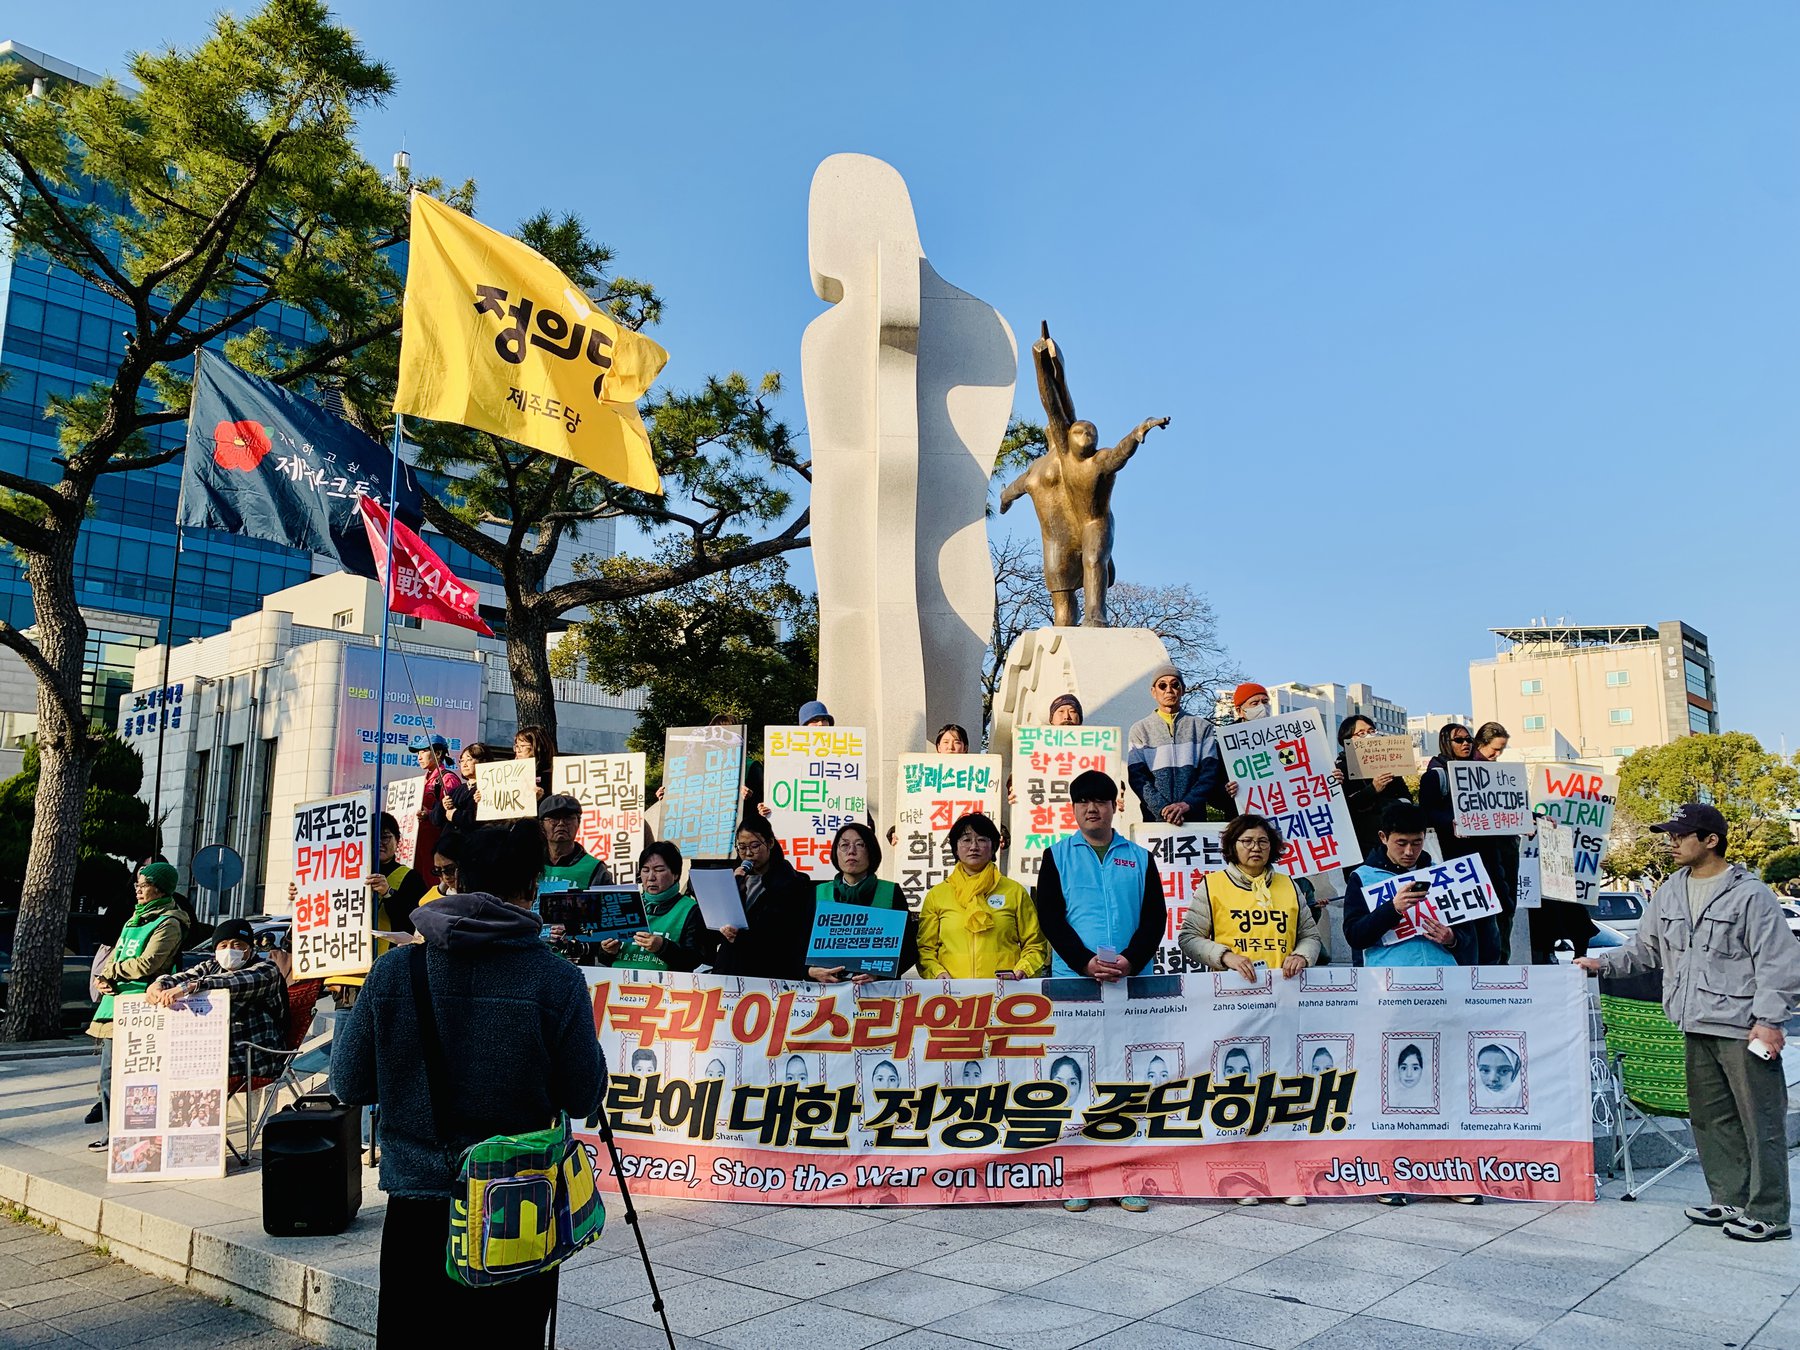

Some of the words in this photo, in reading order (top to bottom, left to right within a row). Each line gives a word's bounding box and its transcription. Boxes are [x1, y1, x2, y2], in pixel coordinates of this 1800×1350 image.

[507, 387, 581, 433] 제주도당
[445, 699, 474, 711] 삽니다.
[393, 713, 436, 729] 2026년,
[769, 731, 863, 757] 한국정부는
[1017, 727, 1118, 755] 팔레스타인
[705, 746, 741, 772] 다시
[809, 760, 859, 781] 미국의
[1029, 751, 1106, 775] 학살에
[1233, 751, 1274, 780] 이란
[1274, 737, 1313, 776] 핵
[565, 759, 633, 785] 미국과
[667, 767, 740, 798] 석유전쟁
[903, 763, 1000, 794] 팔레스타인에
[1454, 766, 1490, 791] END
[1496, 769, 1516, 787] the
[772, 778, 841, 812] 이란에
[845, 796, 865, 813] 대한
[1245, 781, 1288, 816] 시설
[1289, 774, 1340, 808] 공격은
[1545, 768, 1603, 802] WAR
[1601, 795, 1617, 806] on
[494, 789, 525, 812] WAR
[1457, 790, 1529, 813] GENOCIDE!
[295, 800, 368, 842] 제주도정은
[577, 810, 614, 836] 란에
[617, 811, 643, 834] 대한
[899, 808, 923, 824] 대한
[1460, 812, 1491, 831] 학살을
[1148, 835, 1223, 865] 제주는
[1276, 834, 1341, 876] 위반
[296, 841, 363, 885] 무기기업
[295, 889, 330, 932] 한화
[332, 886, 365, 928] 협력
[817, 913, 868, 927] 어린이와
[1230, 909, 1288, 933] 정의당
[814, 937, 871, 949] 미사일전쟁
[829, 927, 852, 936] 민간인
[853, 927, 884, 936] 대량살상
[298, 930, 367, 972] 중단하라
[1233, 938, 1288, 953] 제주도당
[860, 959, 894, 972] 녹색당
[1050, 1009, 1073, 1018] mira
[1075, 1009, 1105, 1017] Malahi
[1212, 1003, 1236, 1011] Zahra
[1237, 1001, 1277, 1011] Soleimani
[118, 1017, 127, 1028] 이
[131, 1014, 165, 1030] 아이들
[593, 981, 727, 1053] 국과
[731, 990, 1056, 1061] 이스라엘은
[127, 1031, 157, 1056] 눈을
[123, 1055, 162, 1075] 보라!
[605, 1072, 724, 1142] 란에
[727, 1080, 864, 1149] 대한
[863, 1080, 1074, 1149] 전쟁을
[1081, 1068, 1358, 1140] 중단하라!
[1371, 1122, 1396, 1130] Liana
[1397, 1121, 1450, 1131] Mohammadi
[1460, 1121, 1512, 1131] fatemezahra
[1513, 1122, 1542, 1131] Karimi
[609, 1147, 702, 1188] Israel,
[711, 1157, 786, 1193] Stop
[792, 1164, 848, 1191] the
[856, 1165, 927, 1188] War
[931, 1165, 977, 1188] on
[985, 1156, 1064, 1189] Iran!
[1324, 1156, 1389, 1186] Jeju,
[1393, 1156, 1475, 1182] South
[1478, 1156, 1561, 1183] Korea
